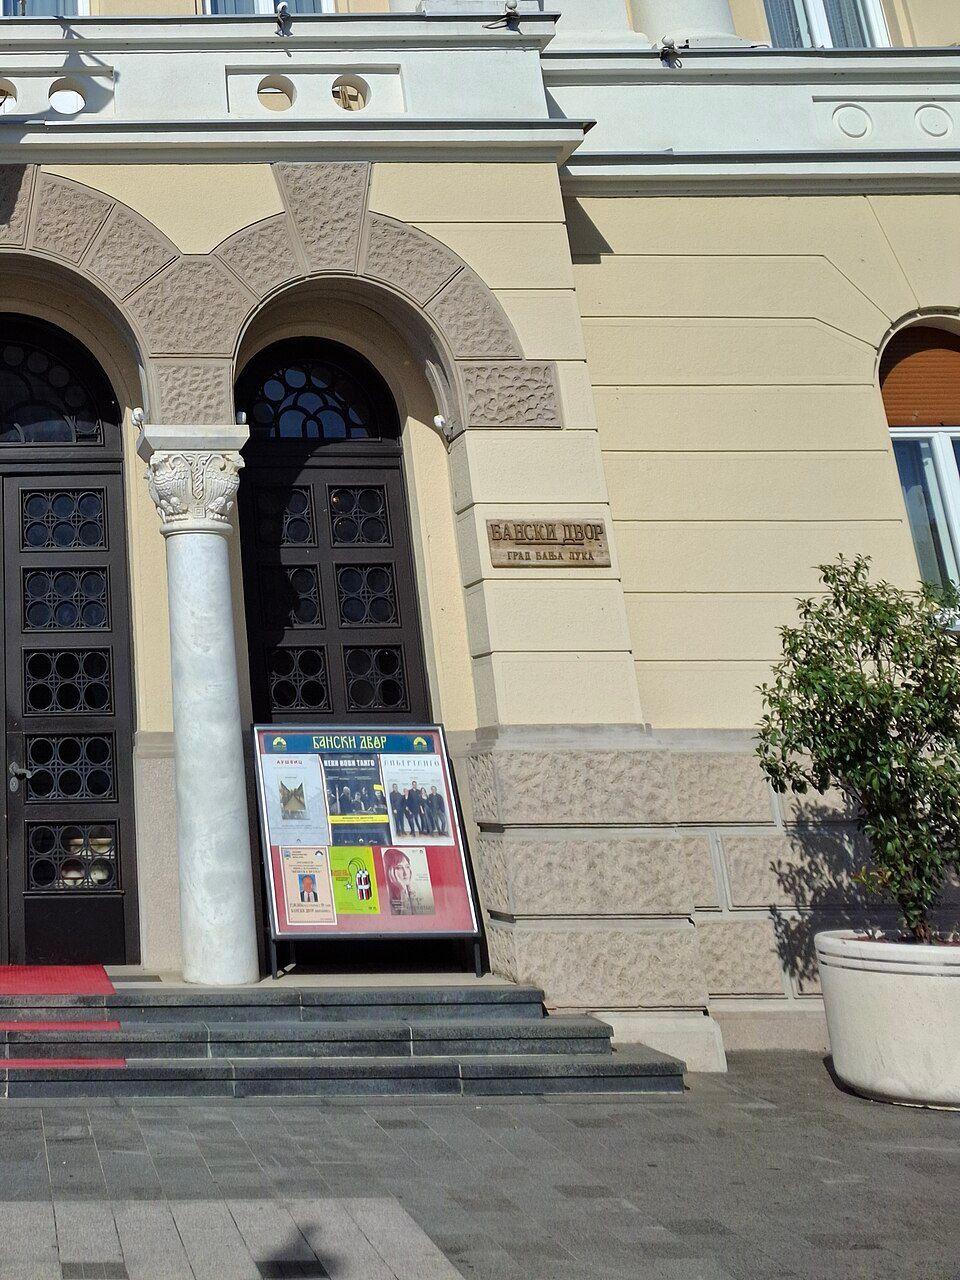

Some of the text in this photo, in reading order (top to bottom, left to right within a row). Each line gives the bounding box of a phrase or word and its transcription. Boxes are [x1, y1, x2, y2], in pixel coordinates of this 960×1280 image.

[490, 523, 604, 543] БАНСКИ ДВОР
[506, 551, 595, 561] ГРАД БАЊА ЛУКА
[359, 735, 387, 750] ДВОР
